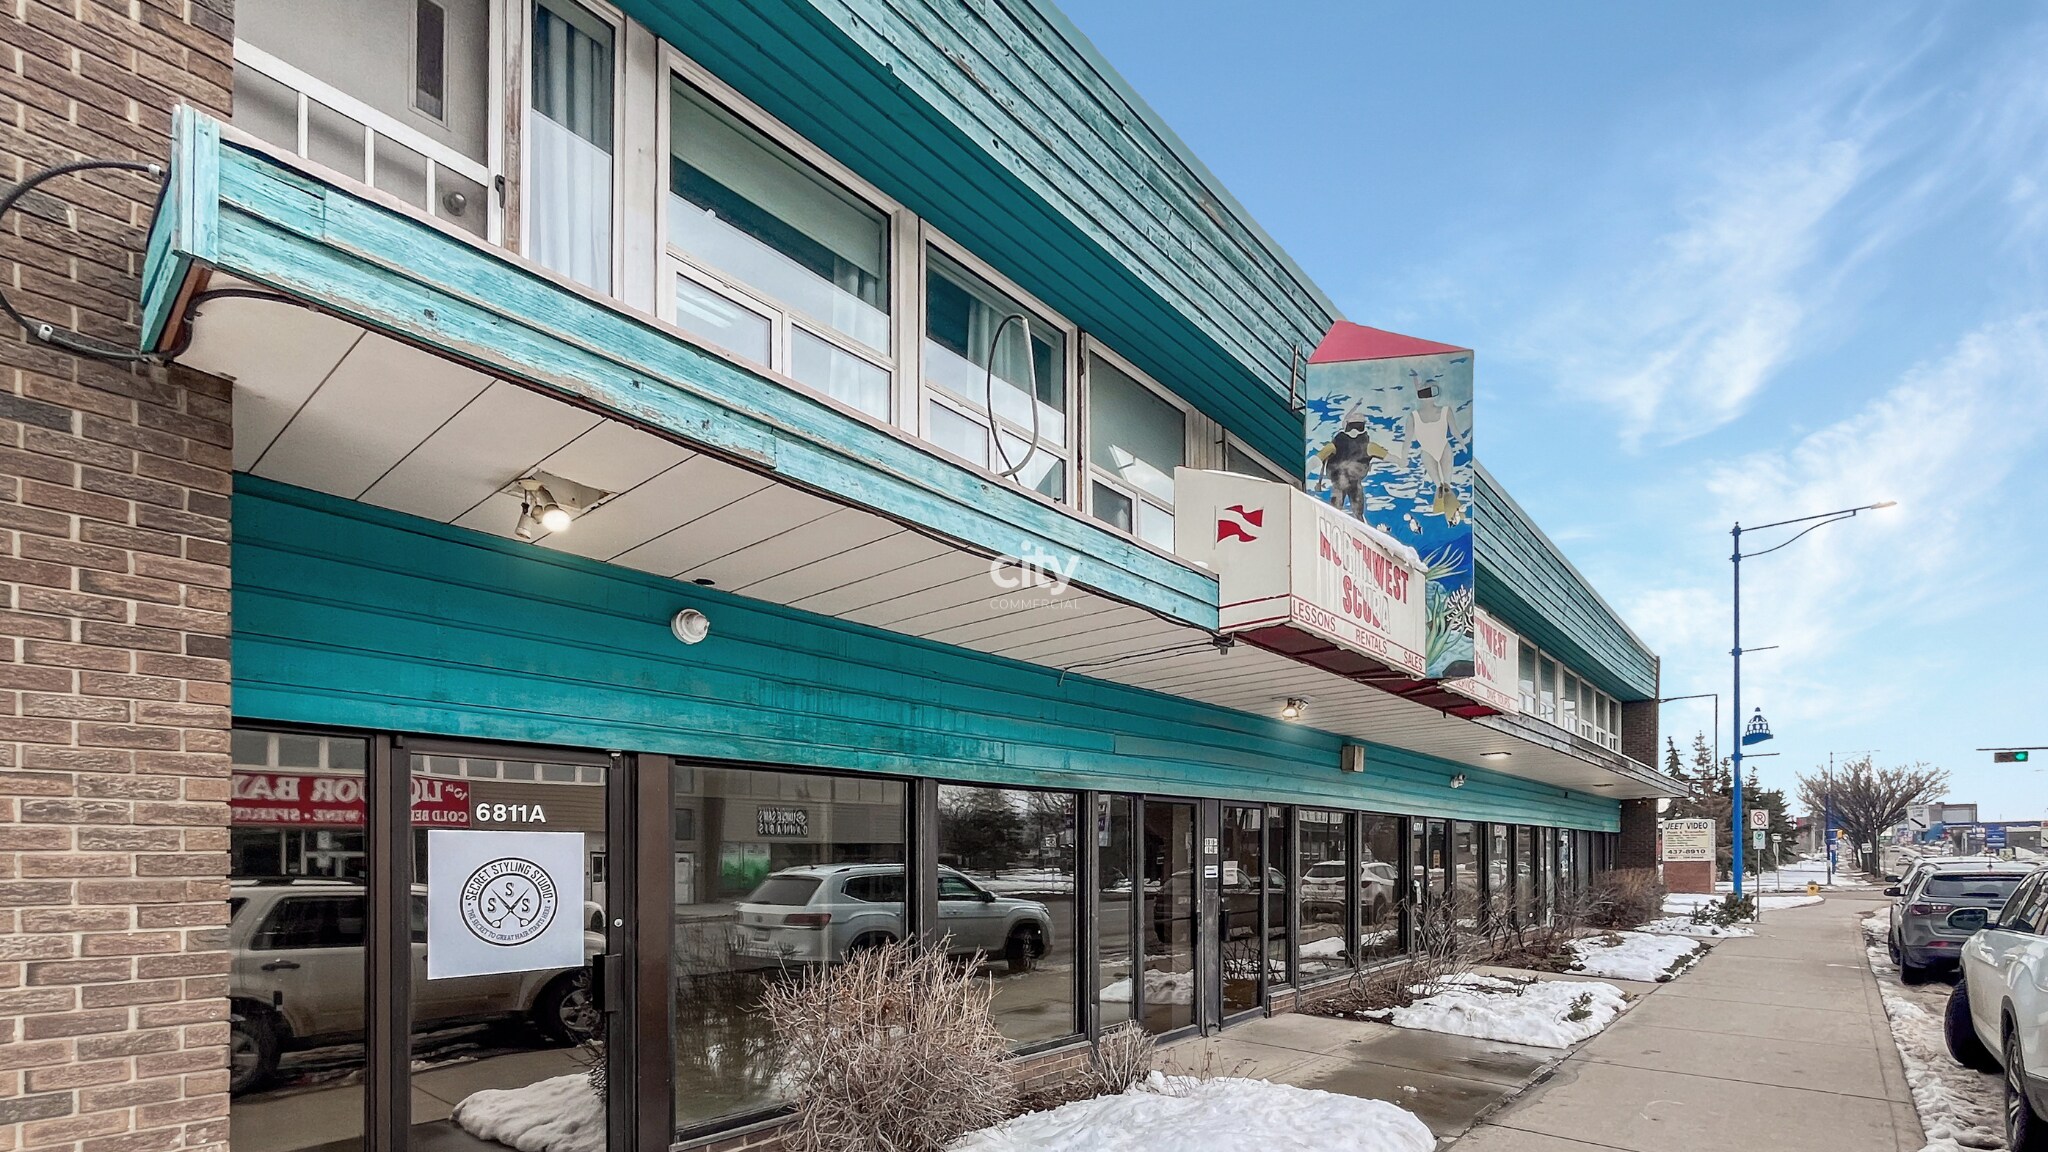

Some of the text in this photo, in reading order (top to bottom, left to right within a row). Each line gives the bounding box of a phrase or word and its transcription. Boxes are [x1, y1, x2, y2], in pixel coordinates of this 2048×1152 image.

[1319, 517, 1409, 605] NORTHWEST
[1342, 574, 1391, 635] SCUBA
[1293, 599, 1424, 671] LESSONS RENTALS SALES
[476, 803, 547, 823] 6811A
[1665, 821, 1708, 830] JEET VIDEO
[465, 861, 554, 901] SECRET STYLING STUDIO
[505, 881, 515, 898] S
[487, 897, 497, 913] S
[521, 898, 531, 913] S
[467, 908, 477, 921] THE
[472, 918, 489, 935] SECRET
[495, 932, 515, 941] GREAT
[514, 930, 530, 940] HAIR
[528, 916, 545, 935] STARTS
[541, 905, 551, 920] HERE
